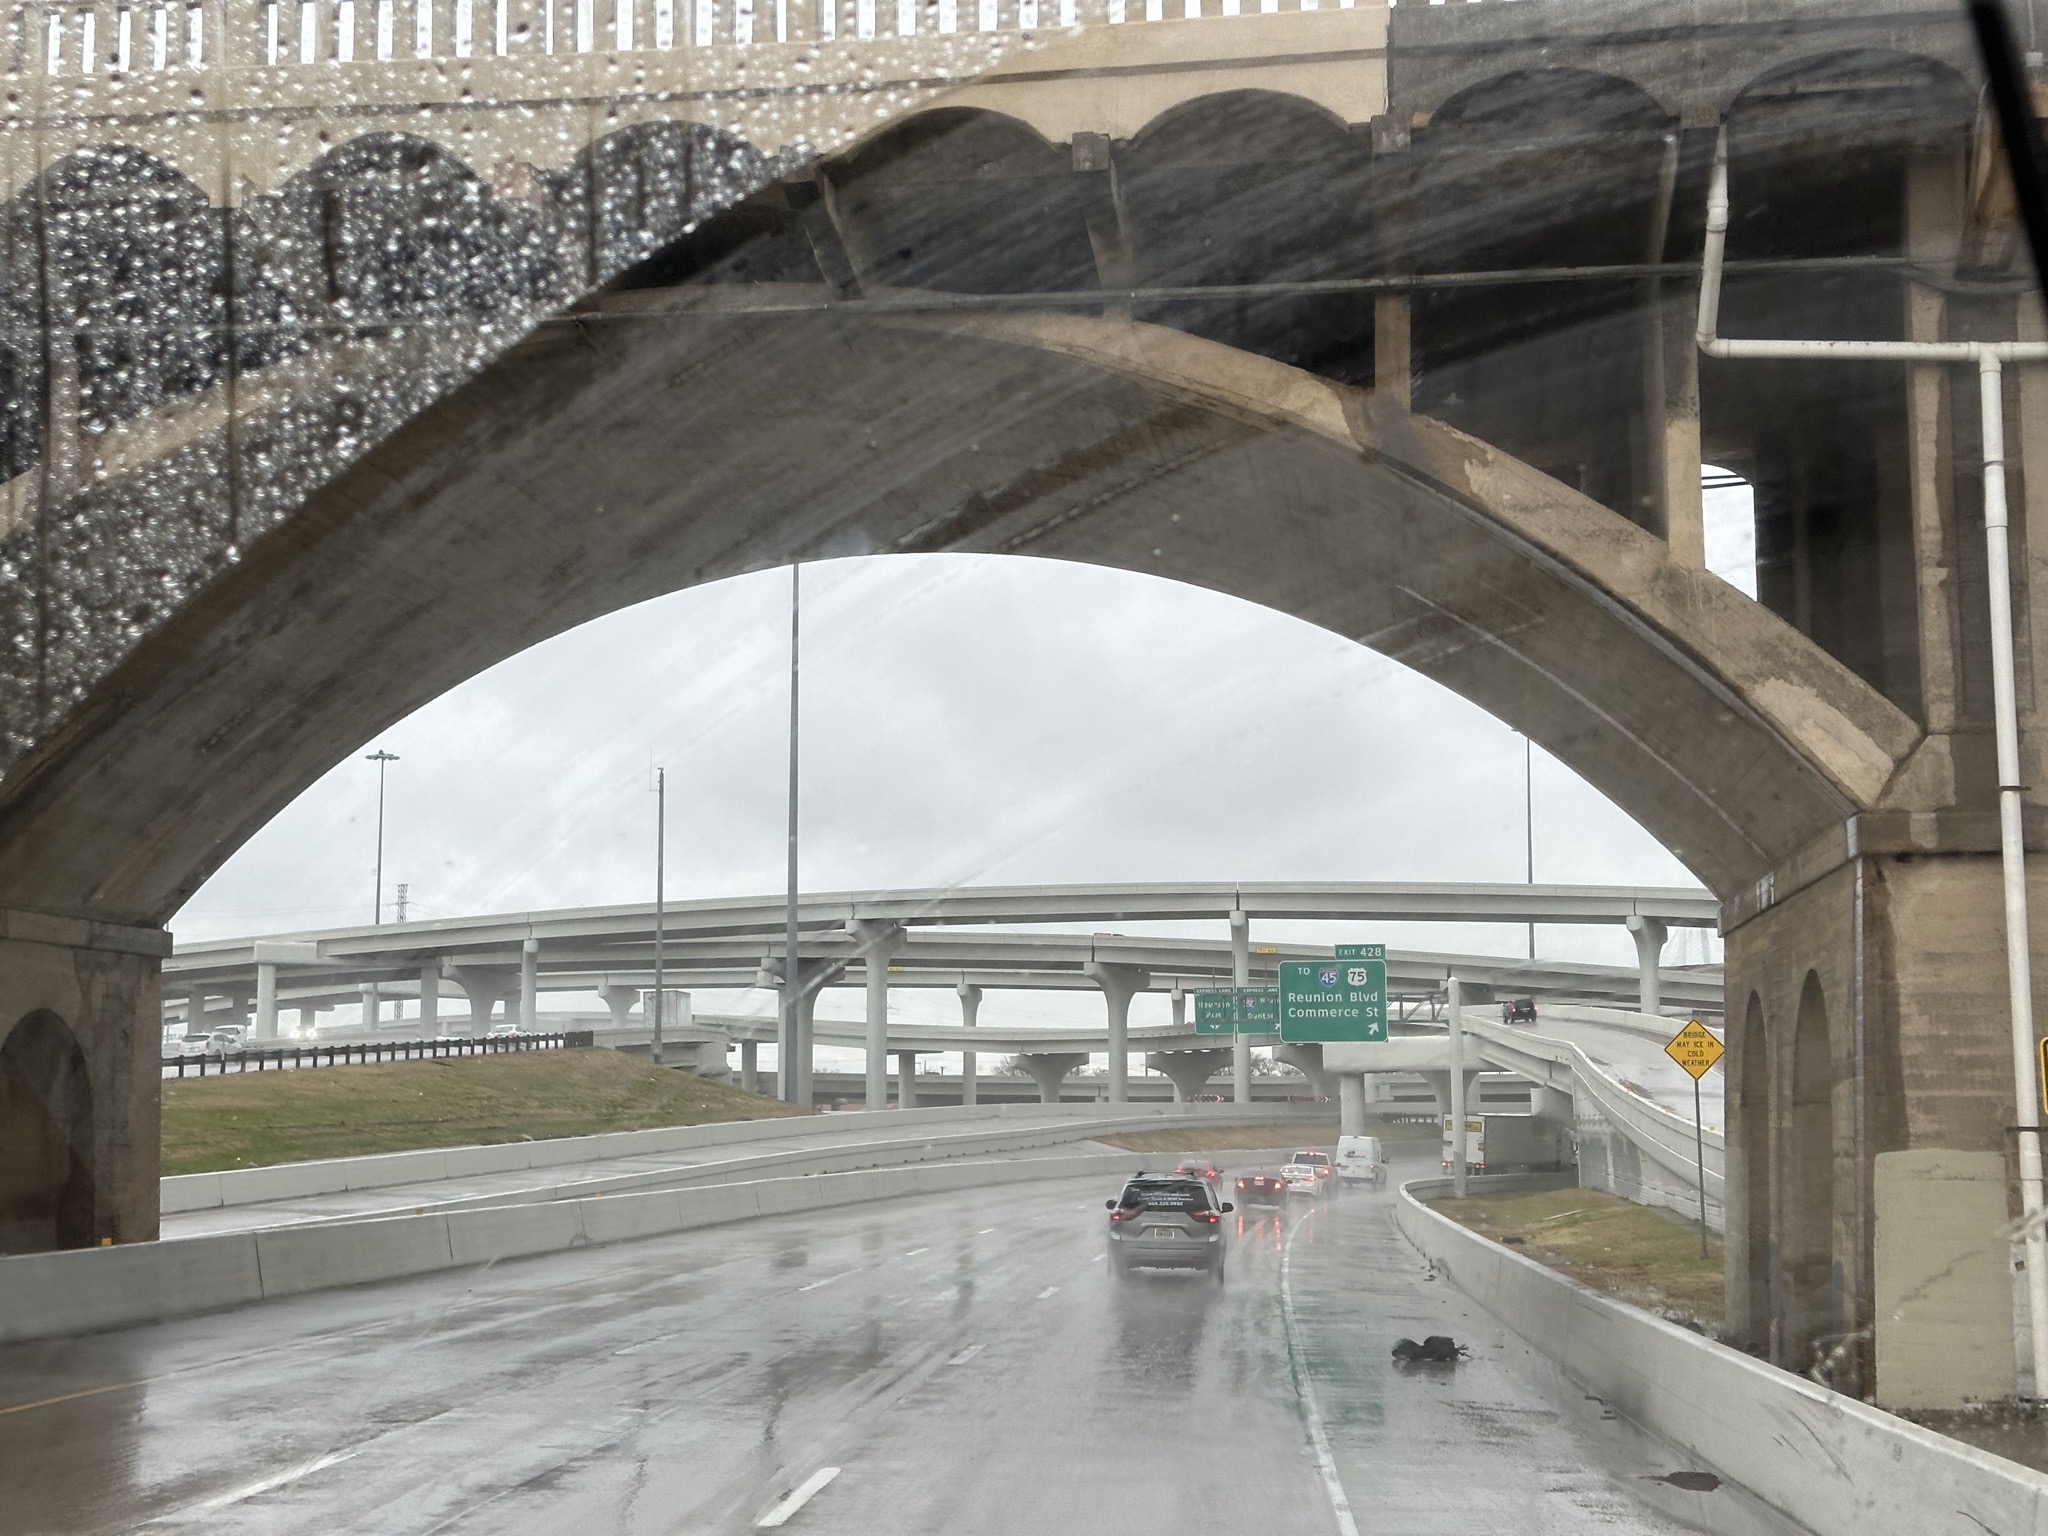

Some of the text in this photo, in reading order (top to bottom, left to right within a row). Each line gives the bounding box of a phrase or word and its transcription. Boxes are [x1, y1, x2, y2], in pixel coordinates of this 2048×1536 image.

[1360, 948, 1381, 956] 428
[1322, 972, 1336, 983] 45
[1350, 972, 1365, 982] 75
[1288, 992, 1342, 1002] Reunion
[1350, 991, 1378, 1002] Blvd
[1288, 1007, 1379, 1017] Commerce St
